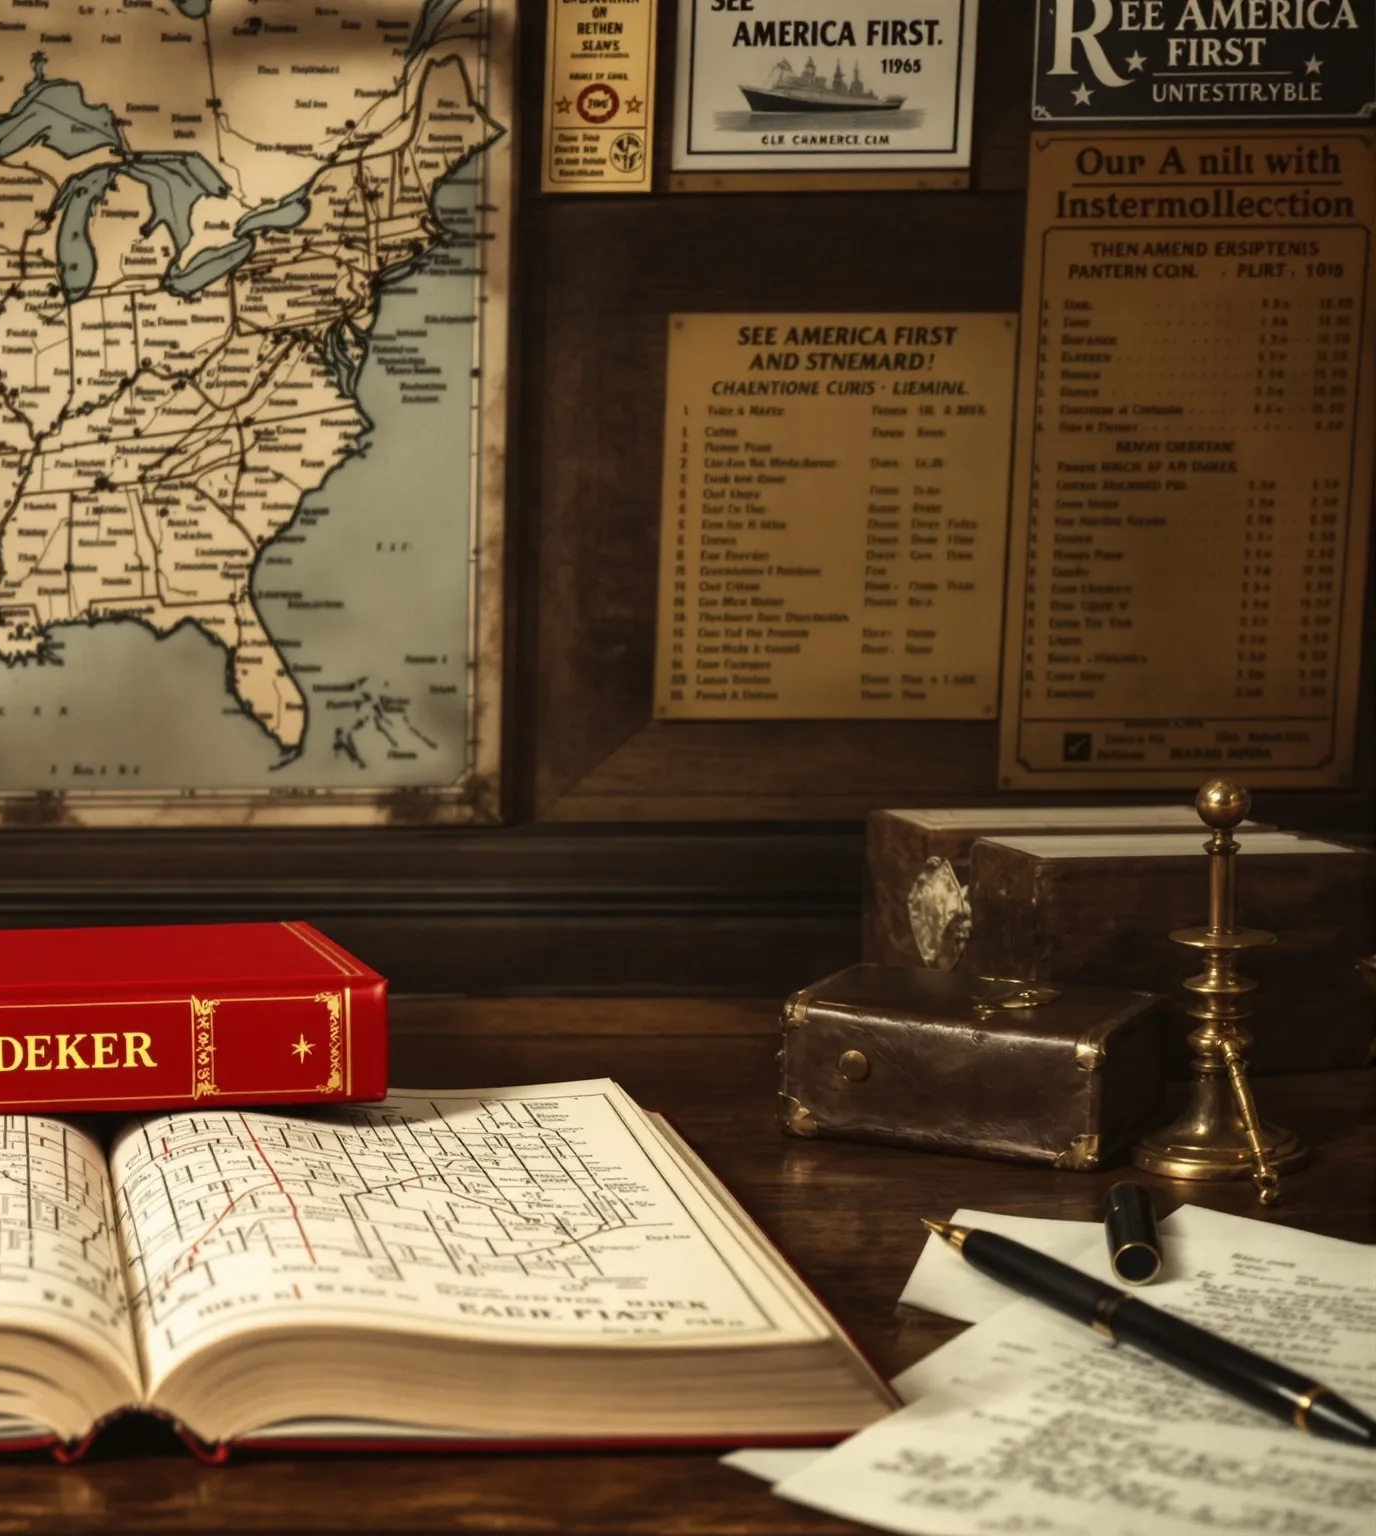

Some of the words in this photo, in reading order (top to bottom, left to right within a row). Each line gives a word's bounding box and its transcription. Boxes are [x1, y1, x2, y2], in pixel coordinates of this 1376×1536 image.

[1175, 0, 1359, 30] AMERICA
[732, 20, 856, 47] AMERICA
[867, 20, 943, 46] FIRST.
[1168, 38, 1266, 67] FIRST
[1077, 146, 1145, 176] Our
[1158, 146, 1187, 174] A
[1265, 144, 1341, 174] with
[738, 326, 778, 346] SEE
[784, 326, 888, 346] AMERICA
[893, 326, 958, 346] FIRST
[748, 353, 800, 371] AND
